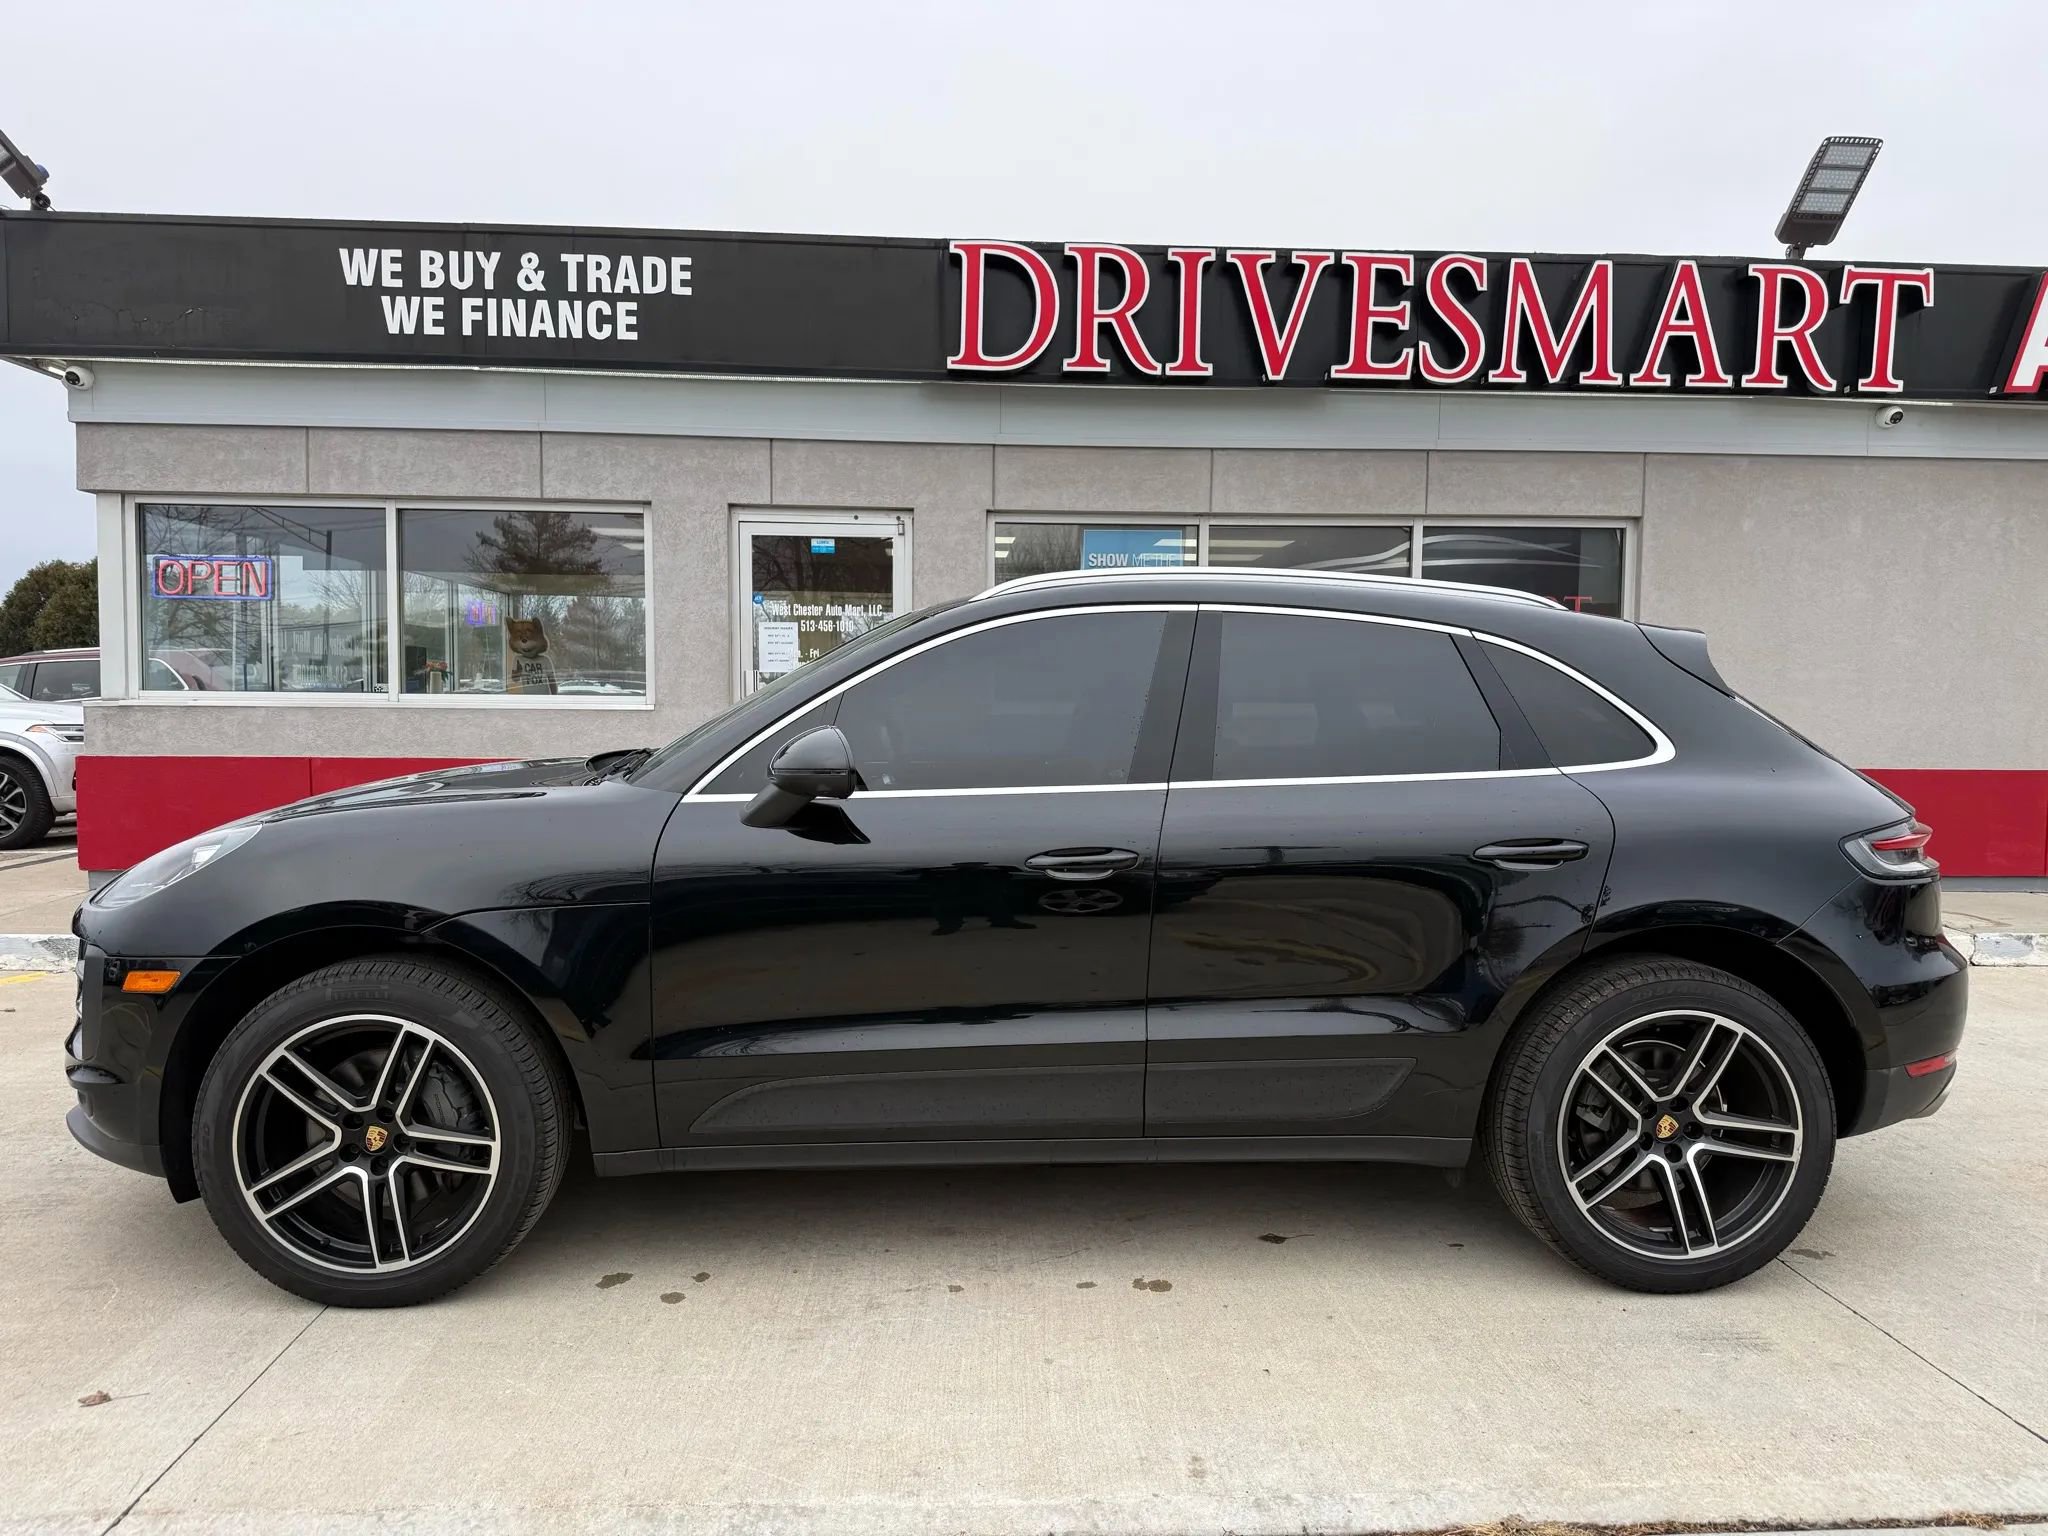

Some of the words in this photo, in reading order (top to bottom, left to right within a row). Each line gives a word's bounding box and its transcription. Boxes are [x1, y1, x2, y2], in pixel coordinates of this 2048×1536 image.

[338, 248, 403, 288] WE
[420, 250, 501, 291] BUY
[516, 251, 546, 291] &
[560, 253, 693, 296] TRADE
[380, 295, 445, 335] WE
[461, 297, 638, 341] FINANCE
[946, 239, 1934, 395] DRIVESMART
[1088, 552, 1129, 567] SHOW
[158, 560, 267, 596] OPEN
[772, 604, 791, 617] West
[793, 604, 823, 617] Chester
[825, 604, 843, 617] Auto
[845, 604, 866, 618] Mart,
[868, 604, 883, 617] LLC
[809, 648, 820, 659] Fri
[524, 662, 543, 674] CAR
